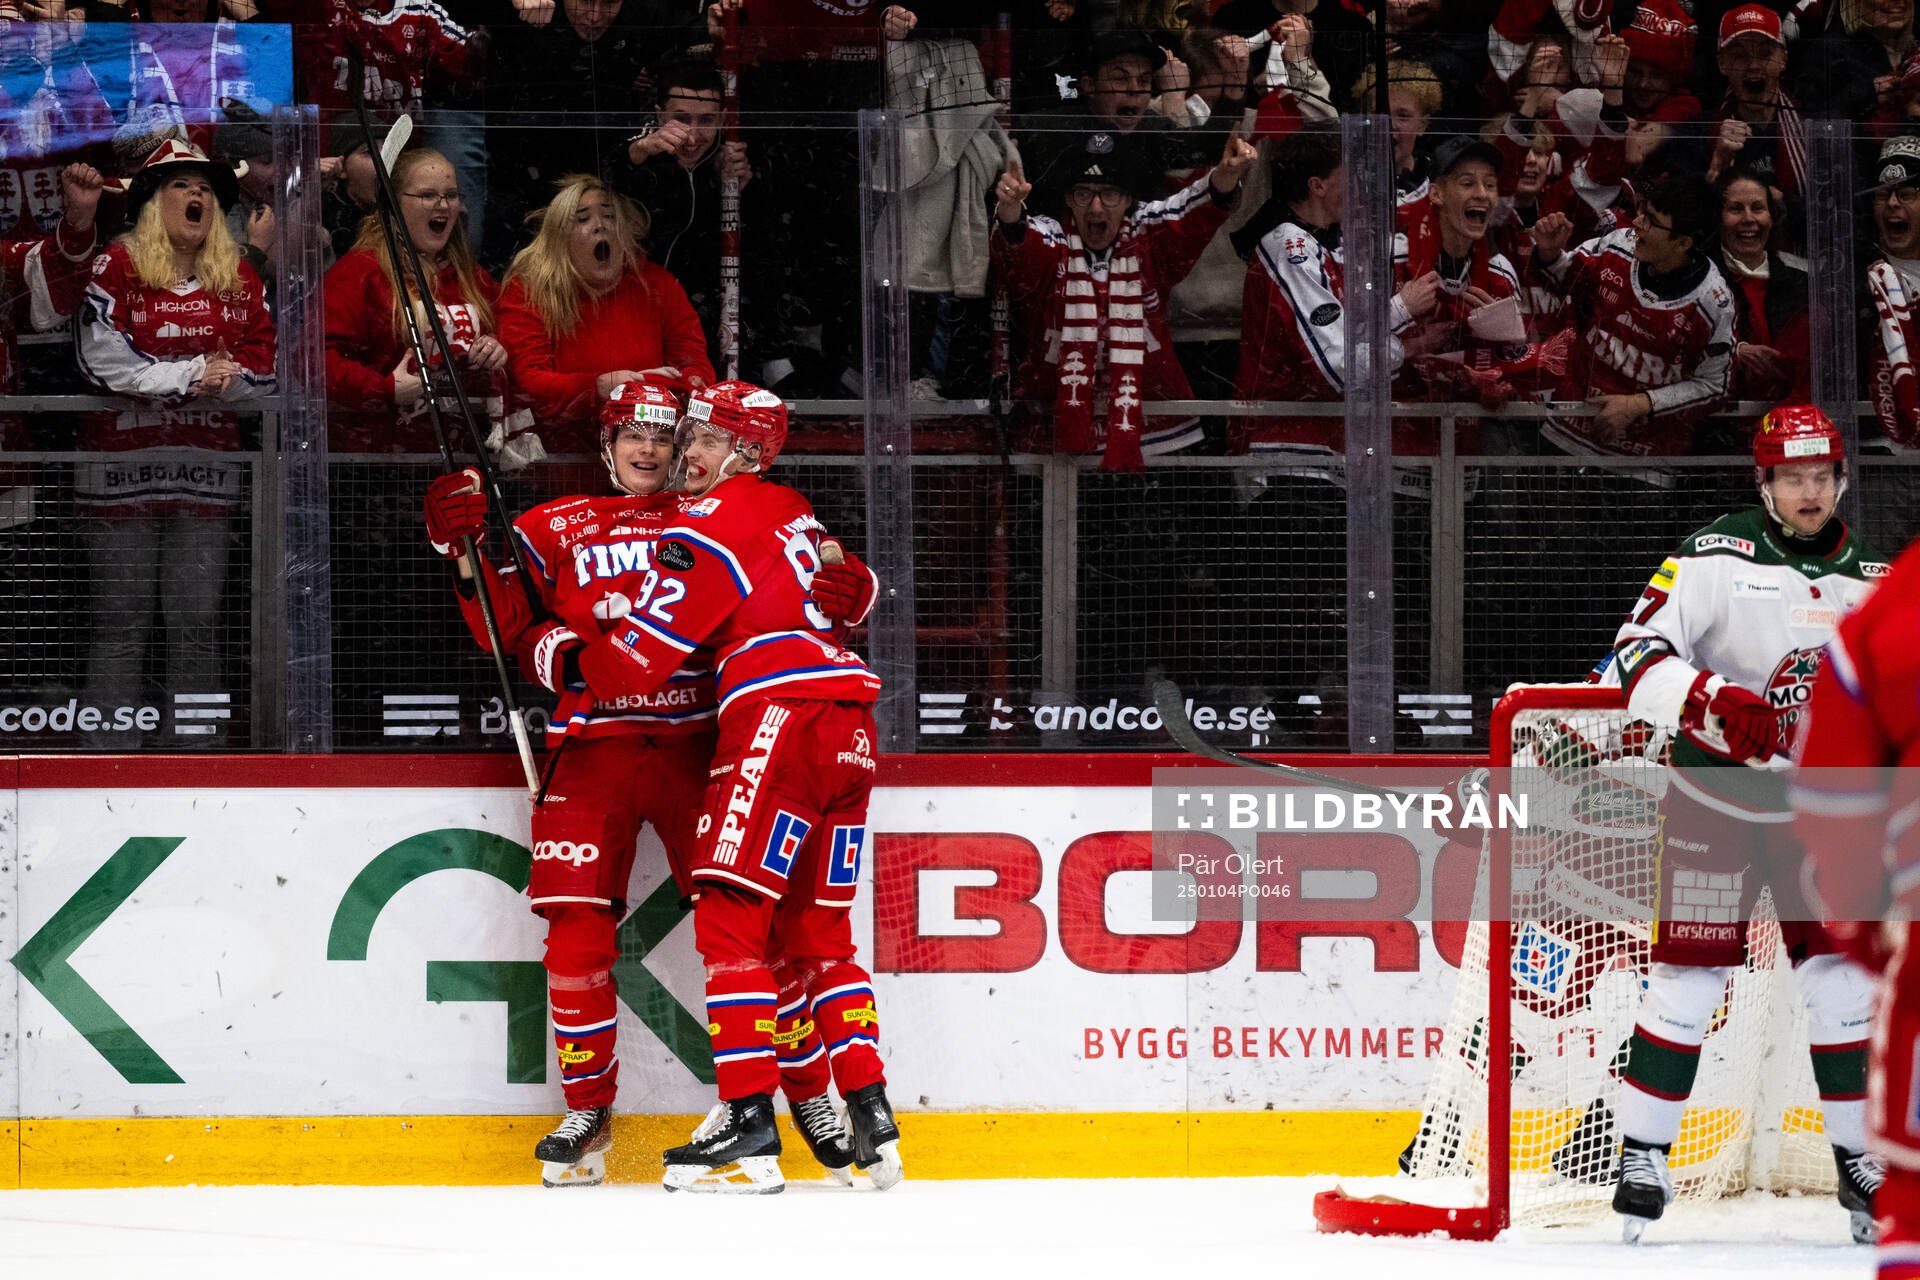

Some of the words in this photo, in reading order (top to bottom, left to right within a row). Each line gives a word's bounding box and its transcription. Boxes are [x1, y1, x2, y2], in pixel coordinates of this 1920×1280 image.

[154, 299, 211, 313] HIGHCON
[181, 325, 214, 338] NHC
[649, 408, 676, 421] LILIUM
[568, 508, 597, 525] SCA
[632, 526, 662, 536] NHC
[575, 540, 659, 588] TIM
[633, 569, 685, 623] 92
[1626, 586, 1669, 627] 7
[624, 630, 640, 646] ST
[0, 698, 160, 732] code.se
[990, 698, 1270, 732] bandcoe.se
[718, 721, 782, 849] PEAB
[533, 840, 600, 867] coop
[1667, 836, 1711, 854] BAUER
[1669, 922, 1738, 941] Lerstenen
[773, 1022, 813, 1043] SUNDFRAKT
[1084, 1027, 1187, 1060] BYGG
[1213, 1026, 1446, 1059] BEKYMMER
